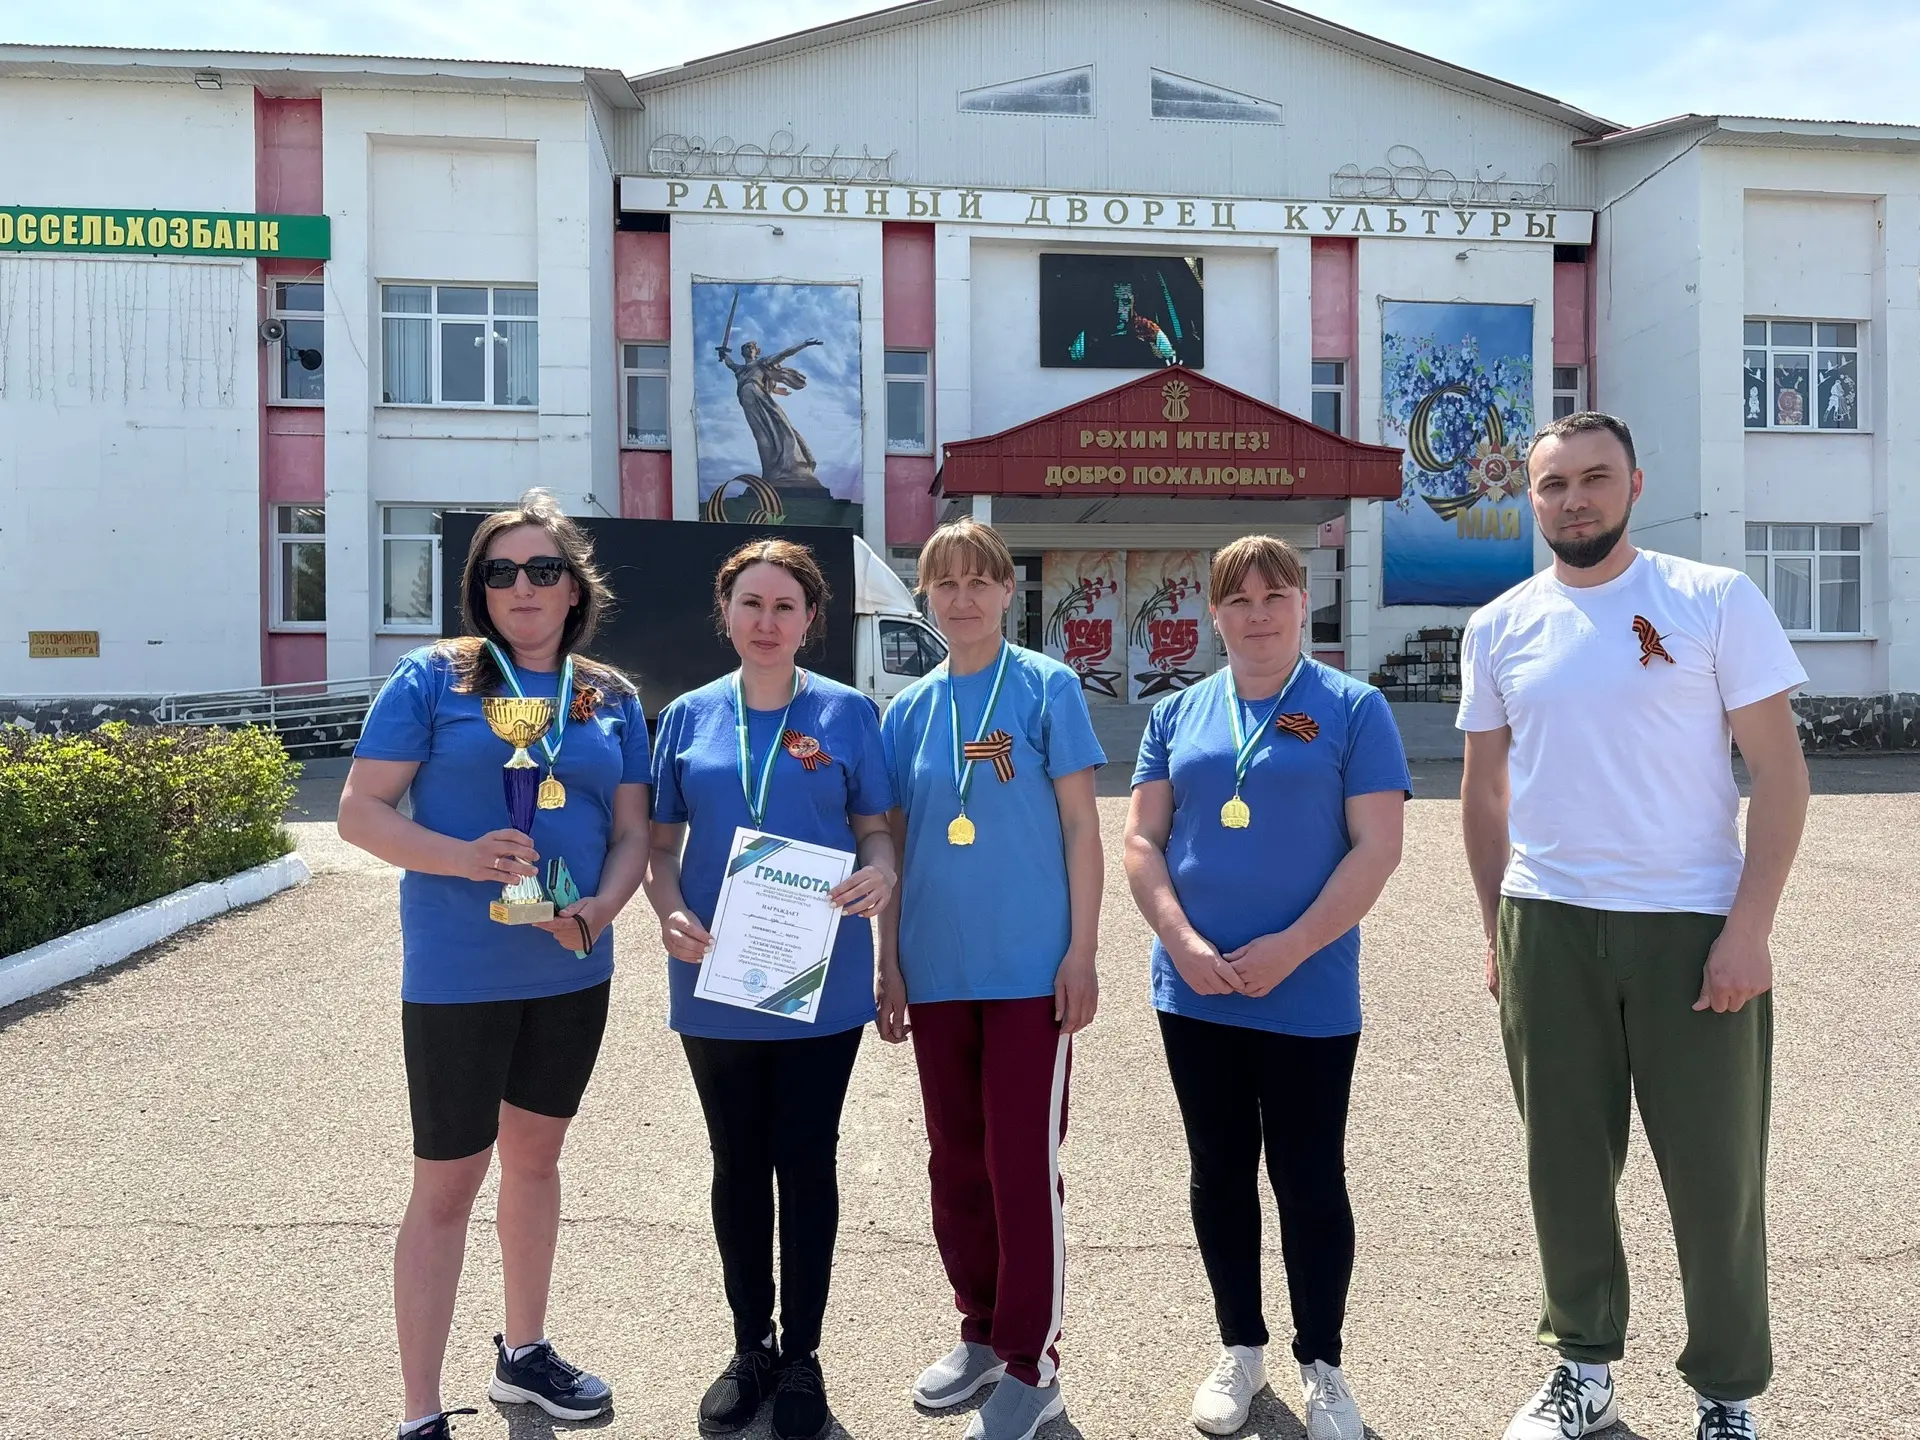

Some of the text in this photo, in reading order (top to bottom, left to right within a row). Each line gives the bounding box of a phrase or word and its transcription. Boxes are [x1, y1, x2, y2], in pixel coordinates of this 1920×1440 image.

[666, 179, 1558, 239] РАЙОННЫЙ ДВОРЕЦ КУЛЬТУРЫ
[1080, 430, 1169, 450] РӘХИМ
[1044, 465, 1126, 487] ДОБРО
[1456, 507, 1521, 540] МАЯ
[1064, 619, 1112, 650] 1941
[1148, 619, 1198, 650] 1945
[754, 865, 829, 893] ГРАМОТА
